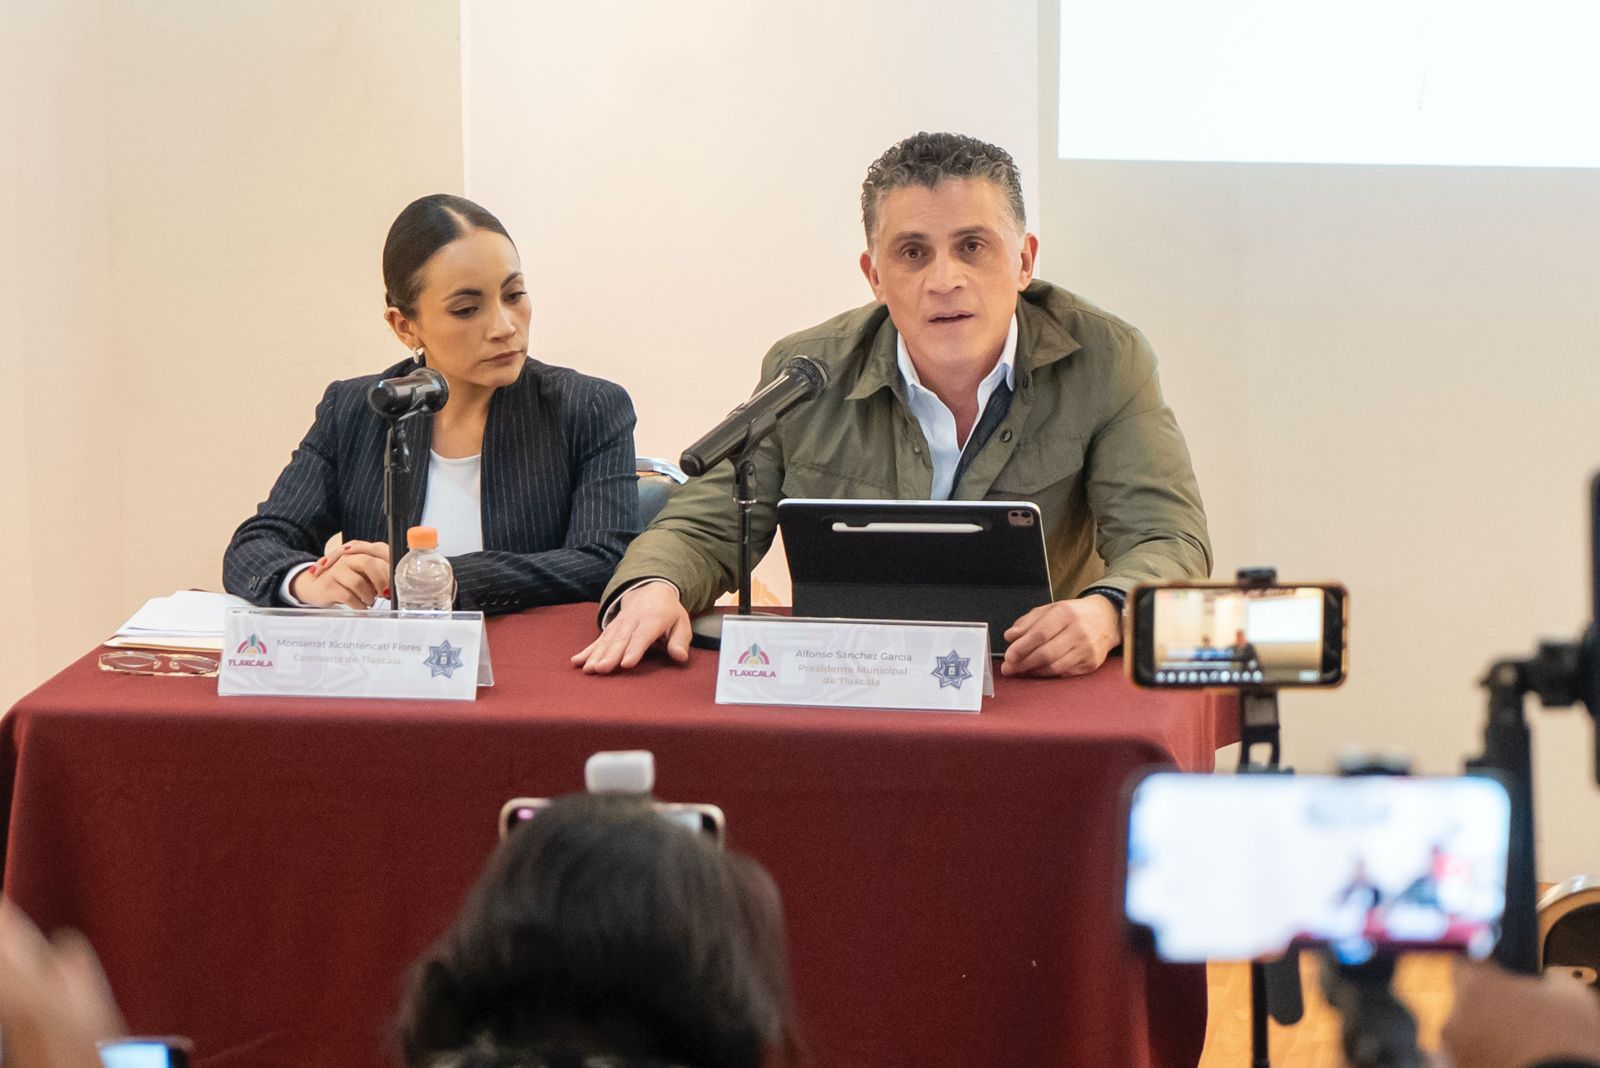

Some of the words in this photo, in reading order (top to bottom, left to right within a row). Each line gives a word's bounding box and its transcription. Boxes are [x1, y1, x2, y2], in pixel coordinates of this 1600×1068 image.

[277, 640, 326, 649] Monserrat
[392, 642, 422, 652] Flores
[345, 654, 358, 664] de
[361, 655, 401, 665] Tlaxcala
[795, 649, 833, 659] Alfonso
[228, 659, 273, 668] TLAXCALA
[729, 669, 776, 678] TLAXCALA
[798, 664, 854, 674] Presidente
[857, 665, 908, 676] Municipal
[822, 676, 836, 685] de
[839, 677, 881, 687] Tlaxcala
